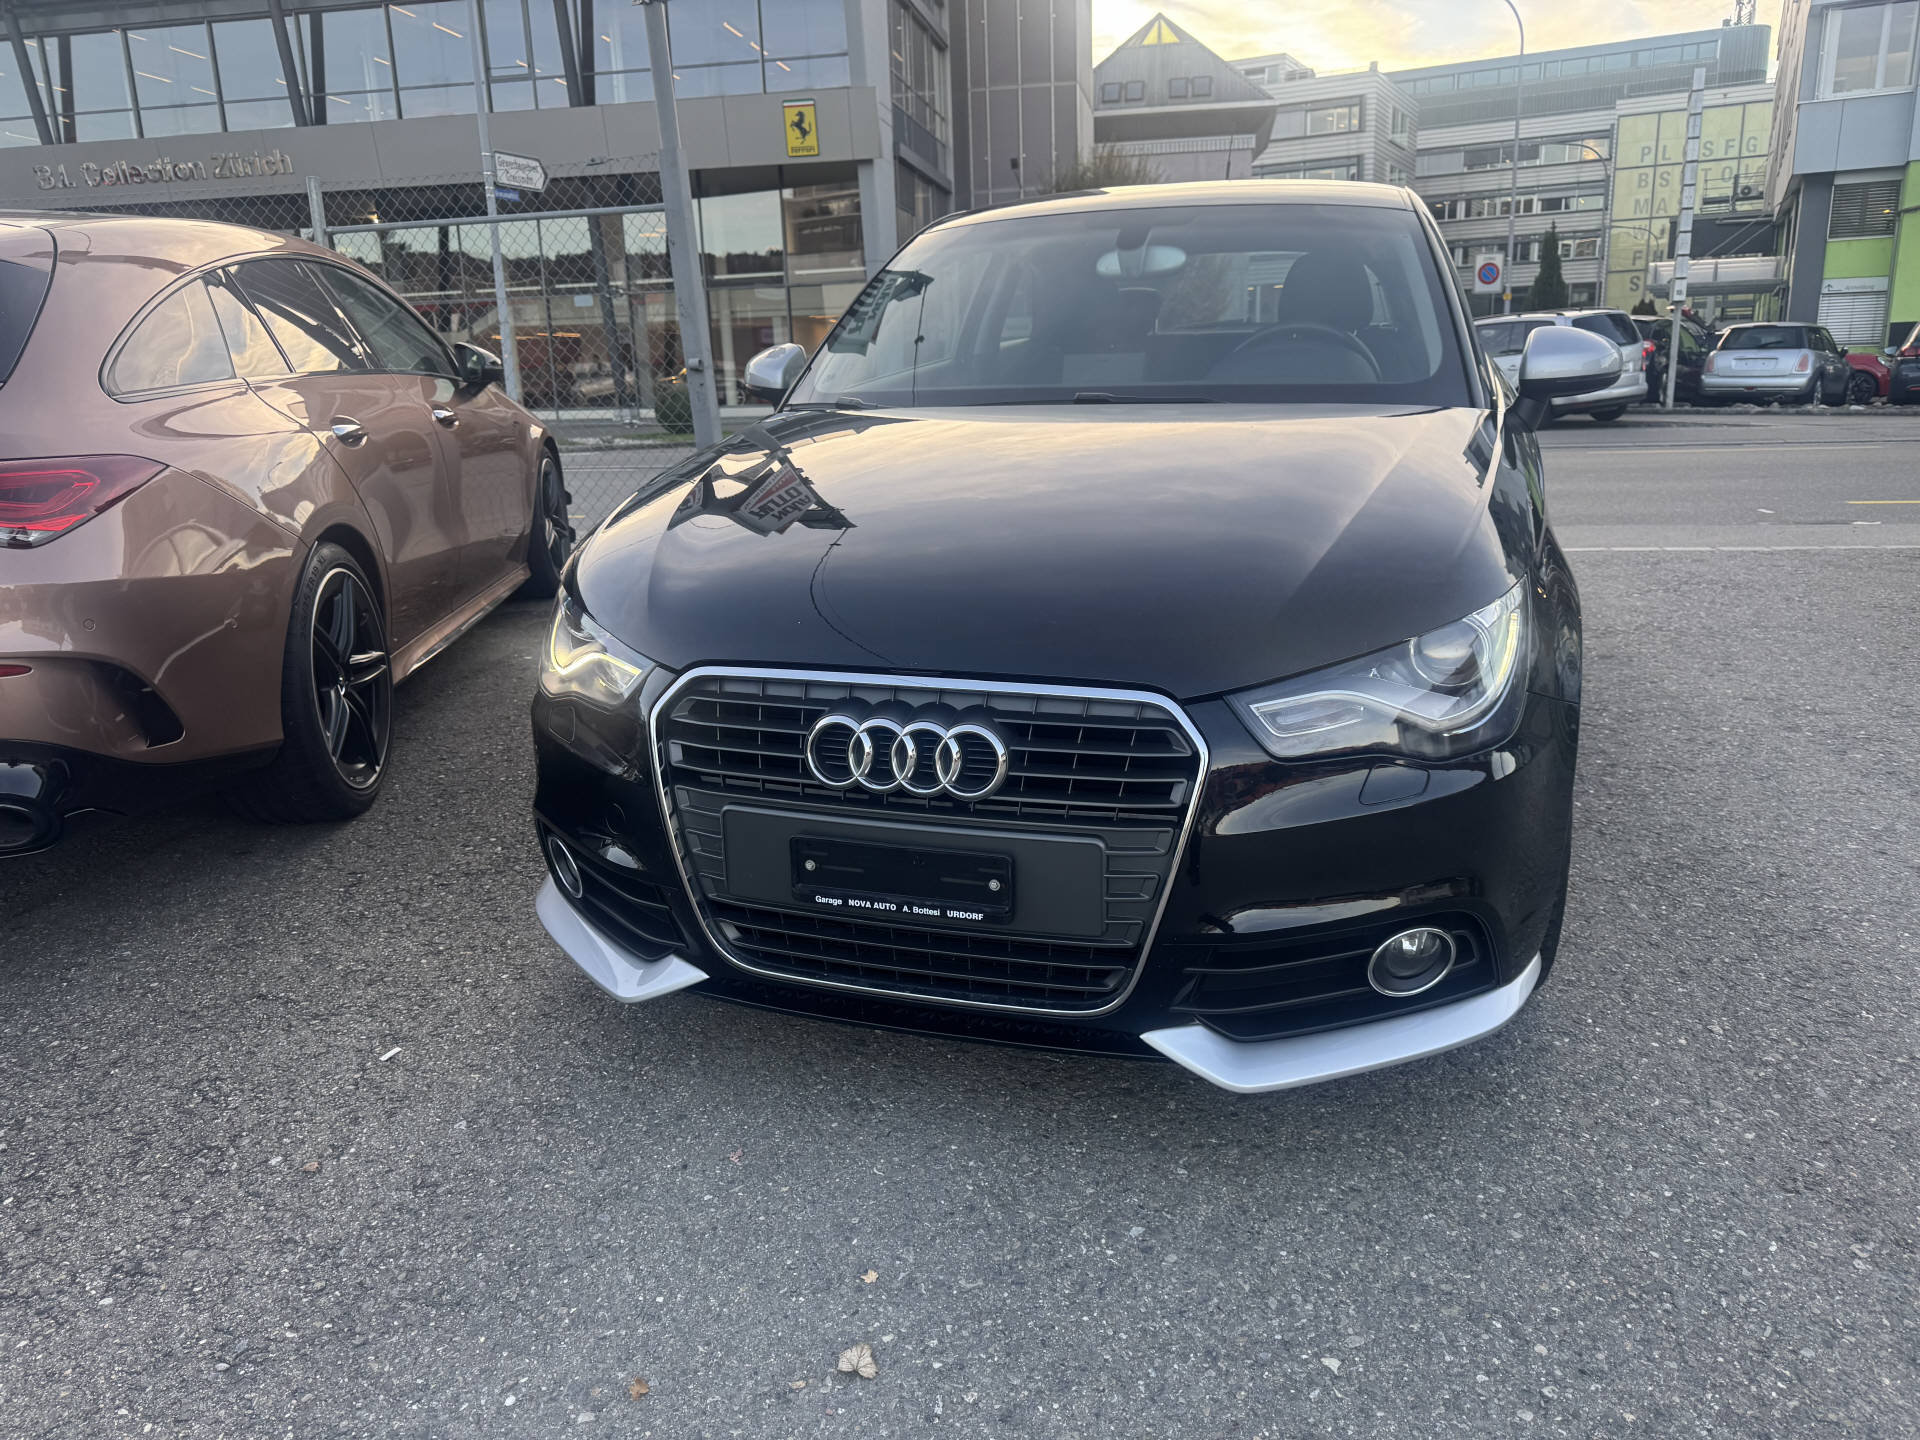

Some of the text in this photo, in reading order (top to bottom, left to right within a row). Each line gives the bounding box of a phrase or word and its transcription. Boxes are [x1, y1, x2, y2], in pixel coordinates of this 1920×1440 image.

[80, 155, 208, 188] Collection
[211, 148, 296, 179] Zürich
[815, 895, 984, 921] Garage NOVA AUTO A. Bottesi URDORF
